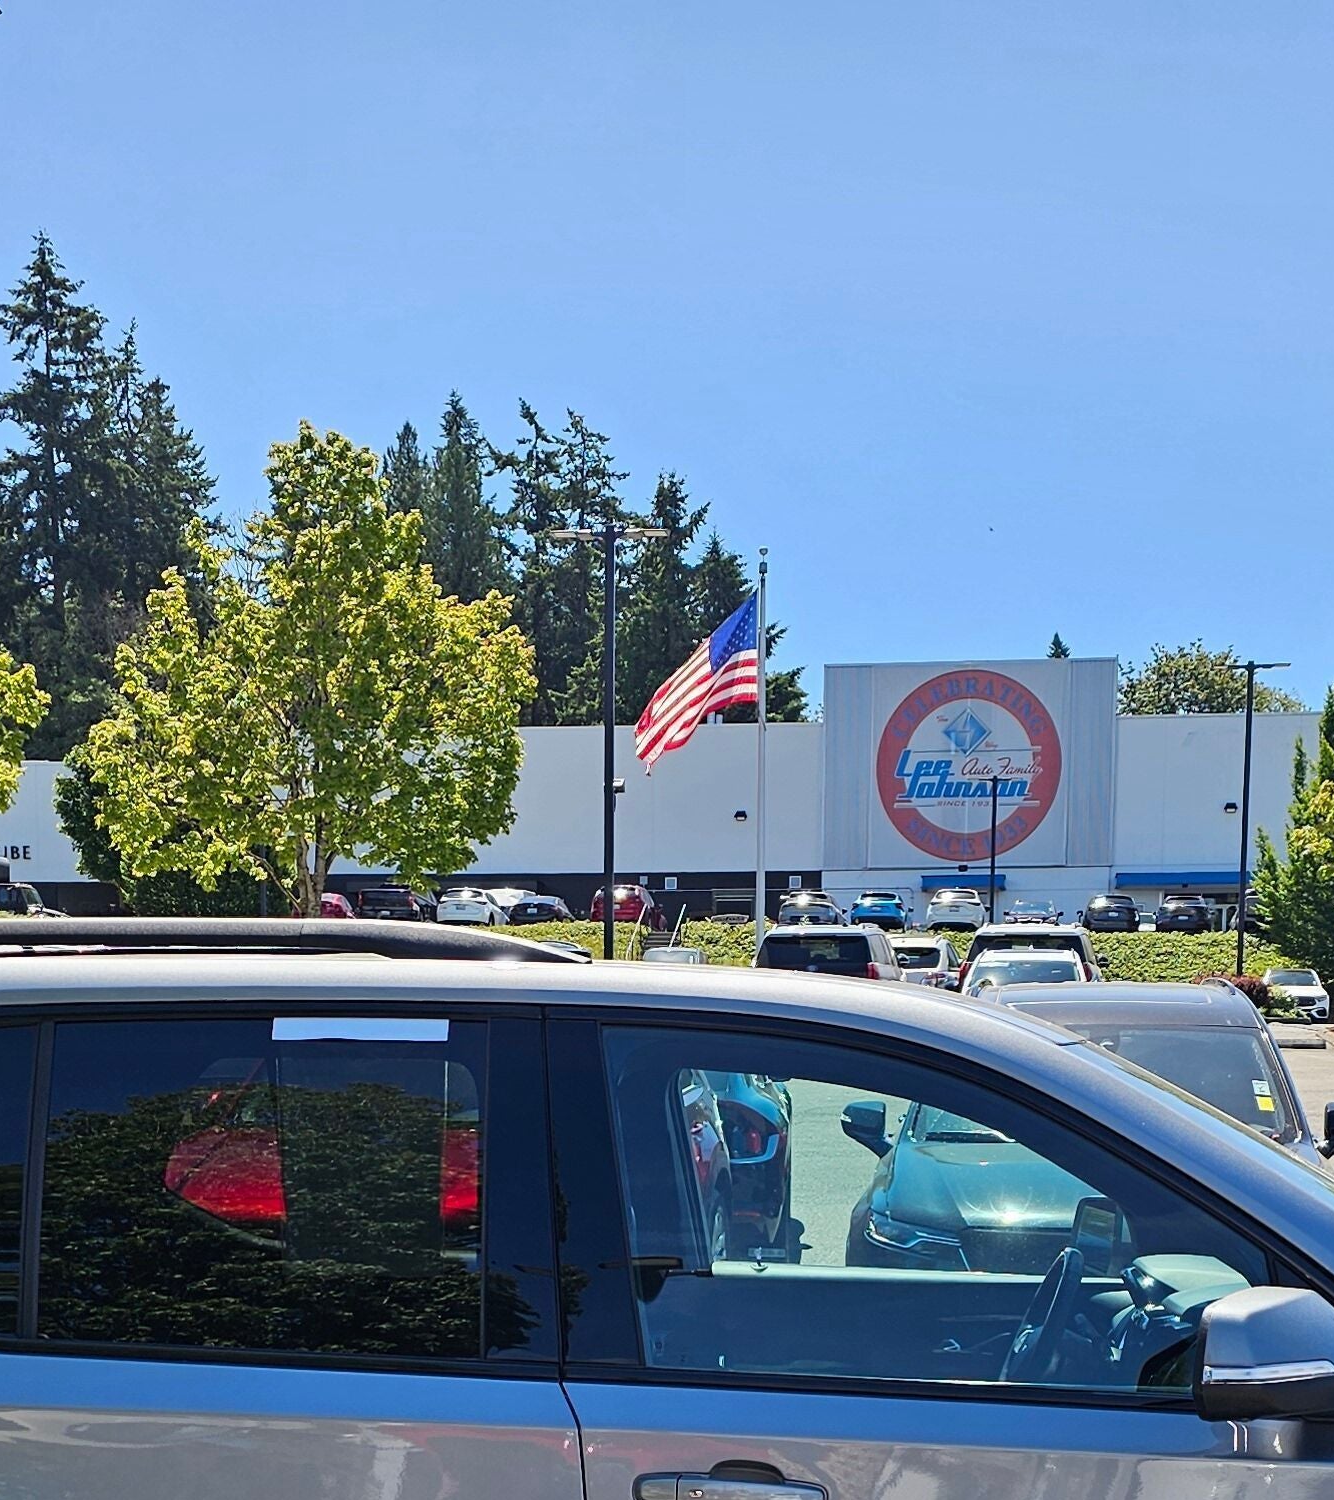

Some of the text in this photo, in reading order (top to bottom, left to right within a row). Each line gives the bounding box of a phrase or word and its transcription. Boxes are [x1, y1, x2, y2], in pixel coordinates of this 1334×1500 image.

[892, 676, 1046, 739] CELEBRATING
[896, 750, 955, 776] Lee
[961, 756, 1043, 777] Auto Family
[898, 773, 1030, 798] Johnson
[908, 815, 976, 856] SINCE
